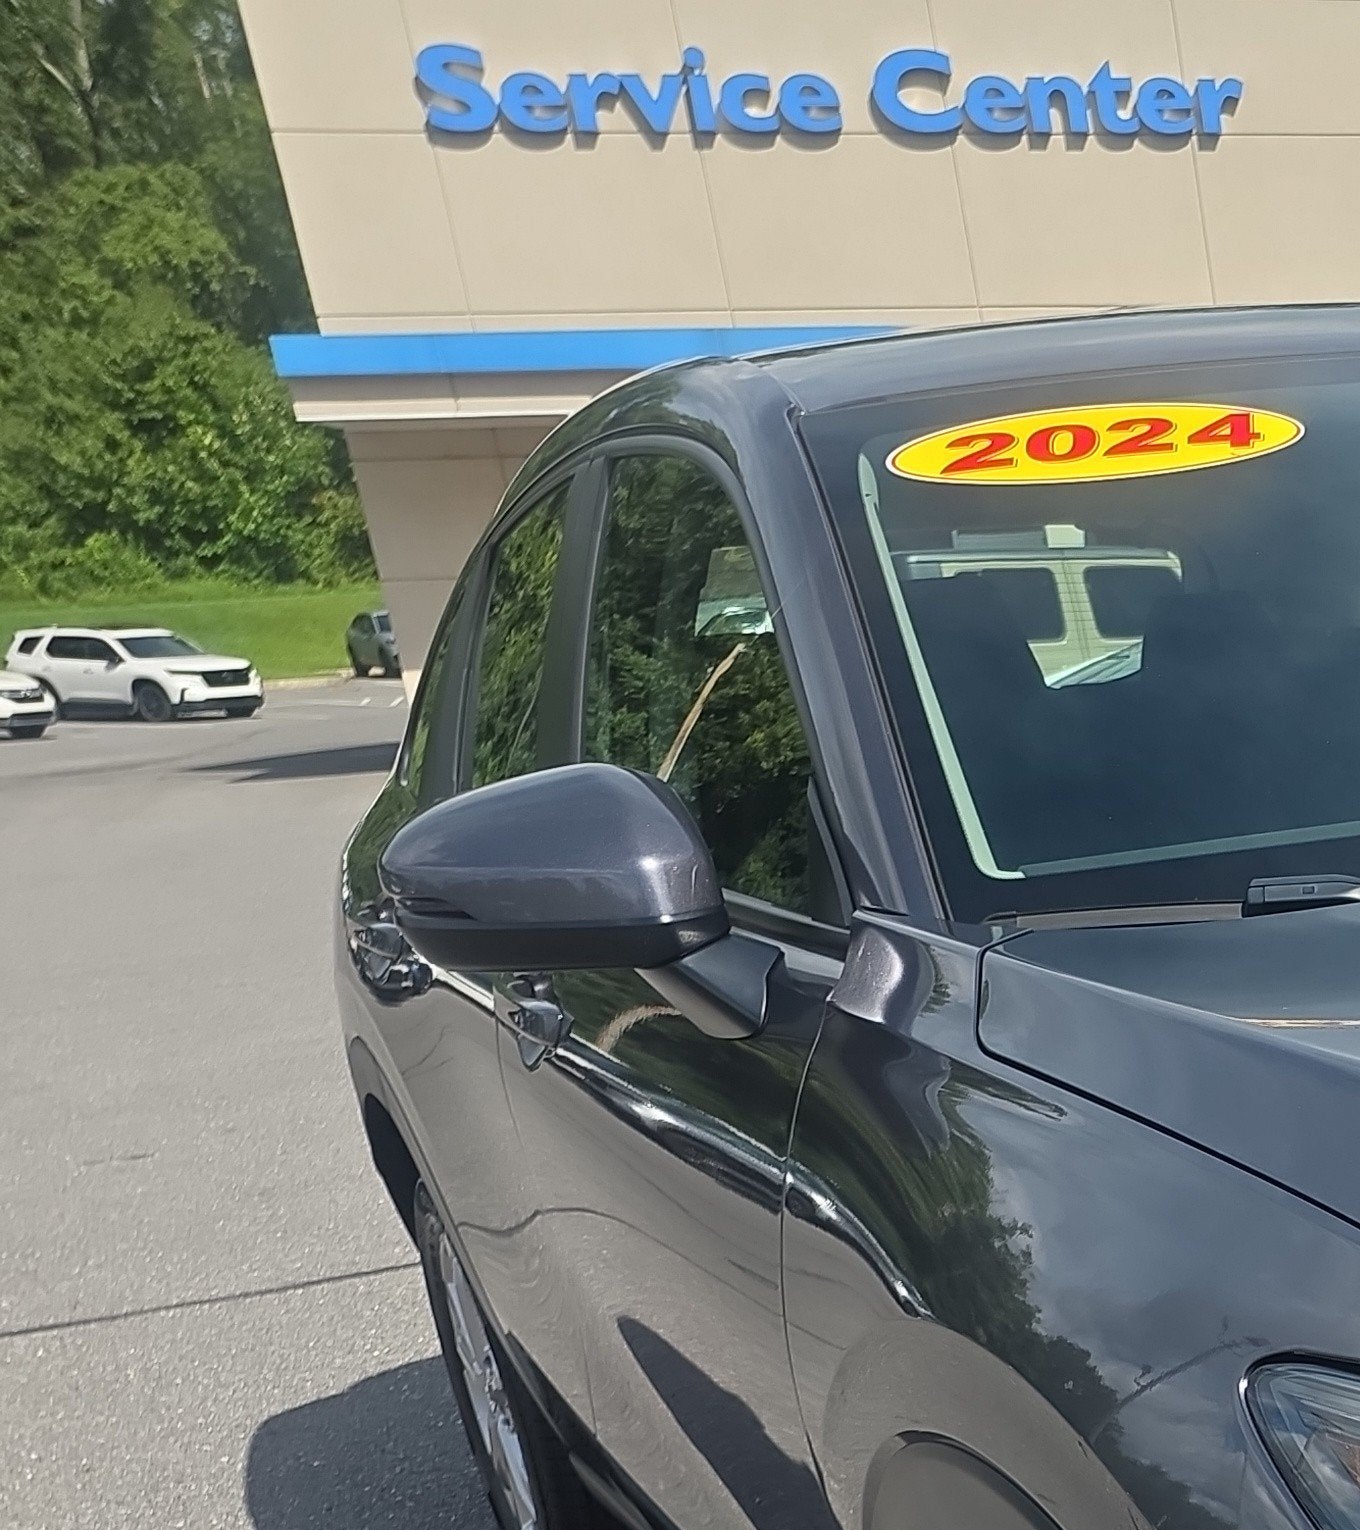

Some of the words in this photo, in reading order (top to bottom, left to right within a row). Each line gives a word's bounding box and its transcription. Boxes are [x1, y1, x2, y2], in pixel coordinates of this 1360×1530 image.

[415, 43, 843, 134] Service
[871, 48, 1243, 136] Center
[939, 411, 1263, 475] 2024
